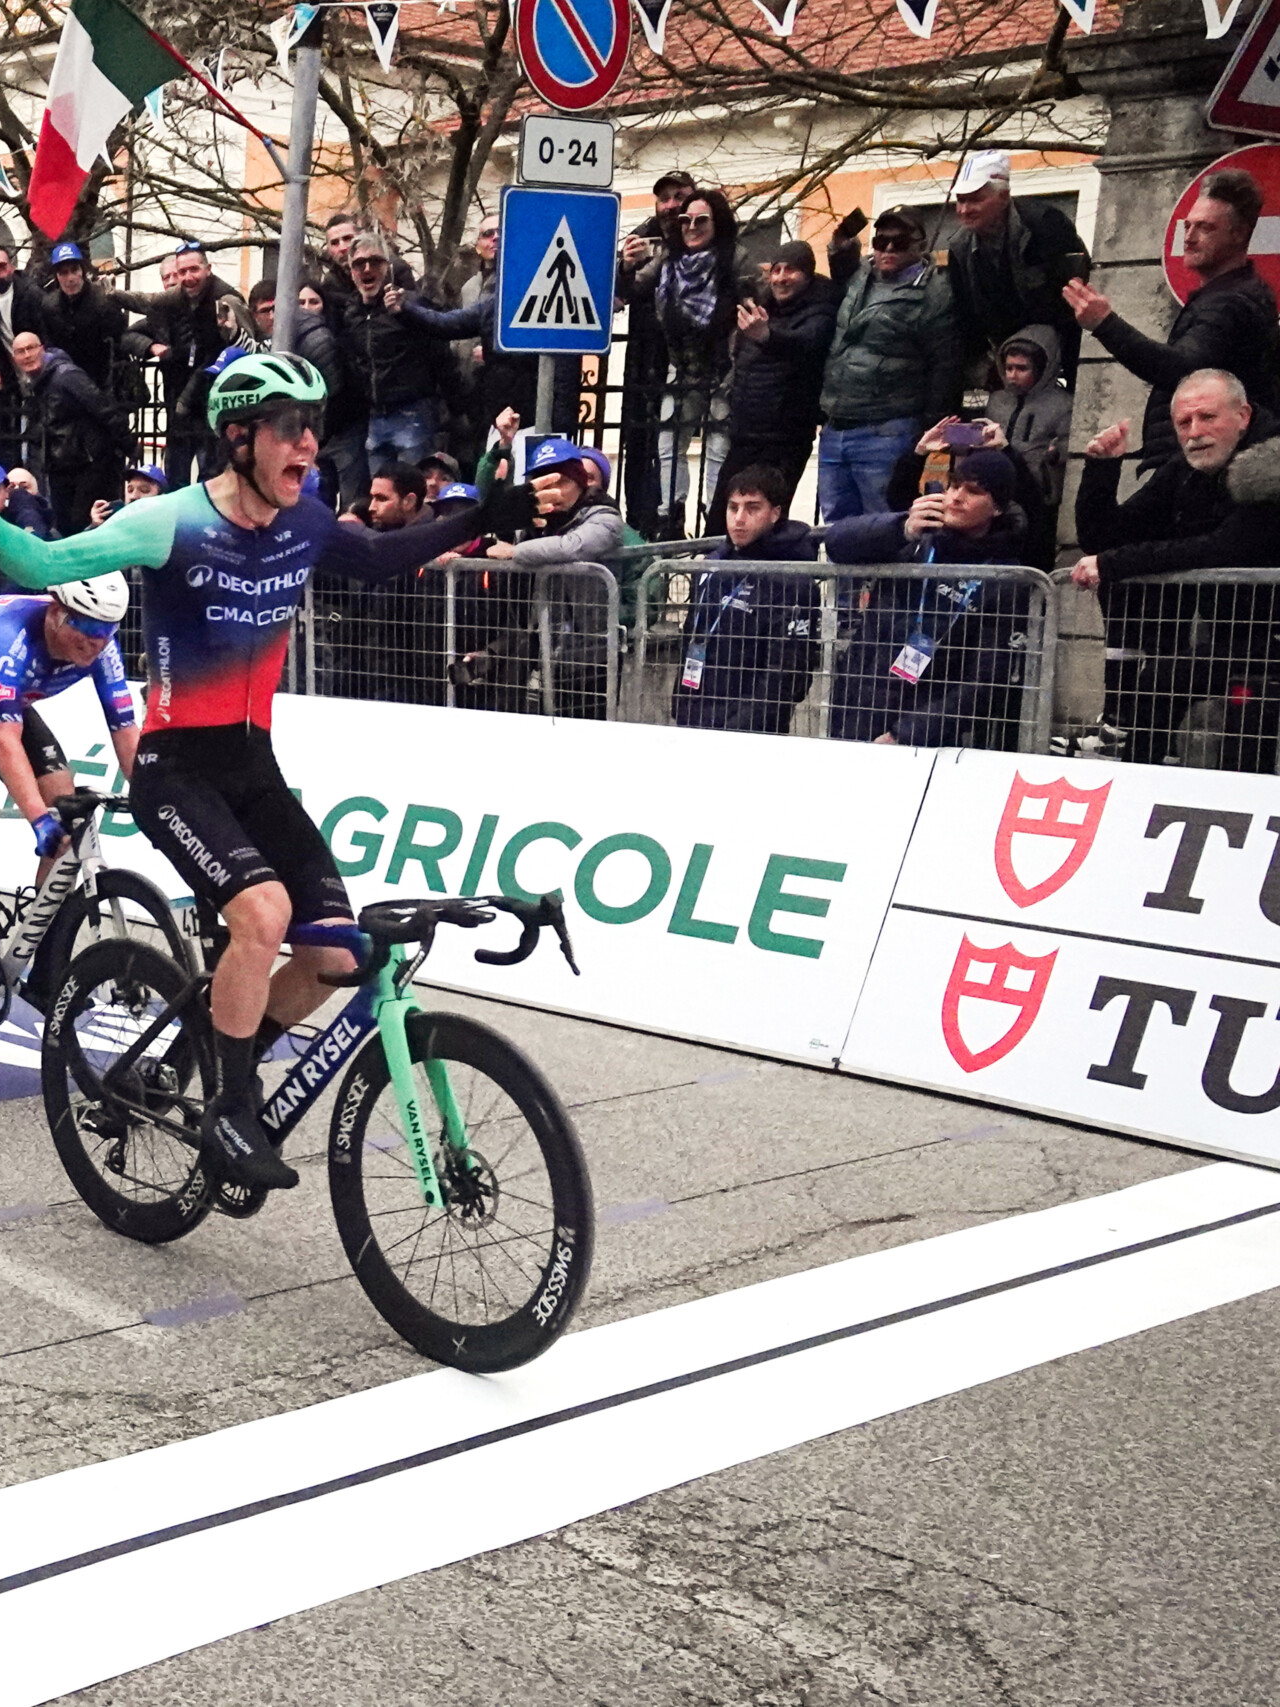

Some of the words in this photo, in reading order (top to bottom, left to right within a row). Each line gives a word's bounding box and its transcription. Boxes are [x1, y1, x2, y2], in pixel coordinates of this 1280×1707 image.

[538, 136, 598, 167] 0-24
[206, 605, 255, 625] CMA
[158, 636, 170, 706] DECATHLON
[170, 815, 231, 887] DECATHLON
[287, 787, 847, 959] GRICOLE
[1143, 803, 1280, 927] T
[12, 860, 82, 960] CANYON
[263, 1078, 307, 1130] VAN
[302, 1017, 361, 1087] RYSEL
[405, 1100, 422, 1134] VAN
[414, 1138, 433, 1186] RYSEL
